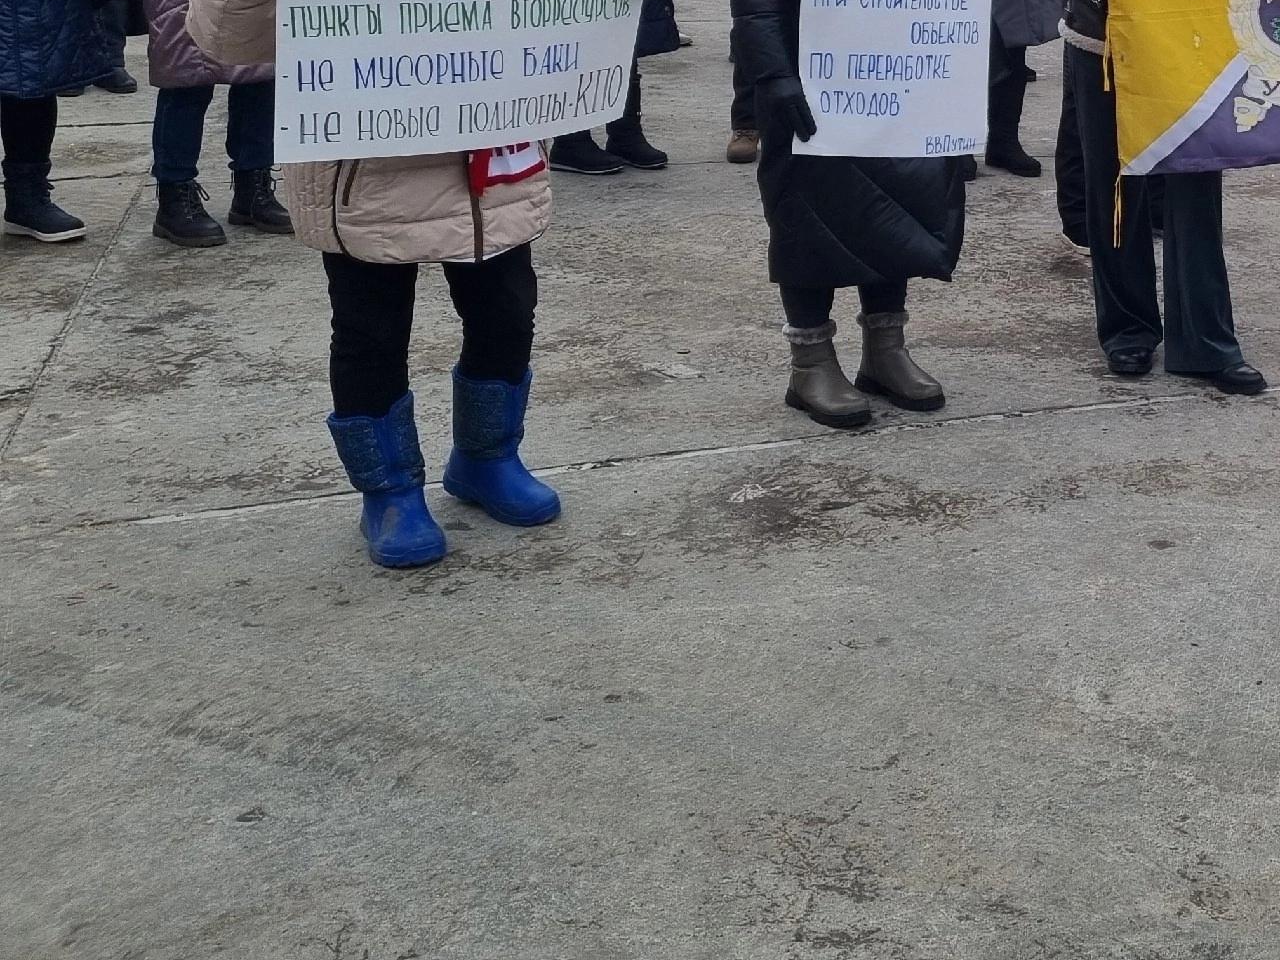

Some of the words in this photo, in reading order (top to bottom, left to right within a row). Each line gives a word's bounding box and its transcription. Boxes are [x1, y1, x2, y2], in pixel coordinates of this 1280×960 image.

[910, 21, 980, 46] ОБЪЕКТОВ
[522, 41, 581, 78] БАКИ
[809, 52, 834, 81] ПО
[847, 53, 952, 82] ПЕРЕРАБОТКЕ
